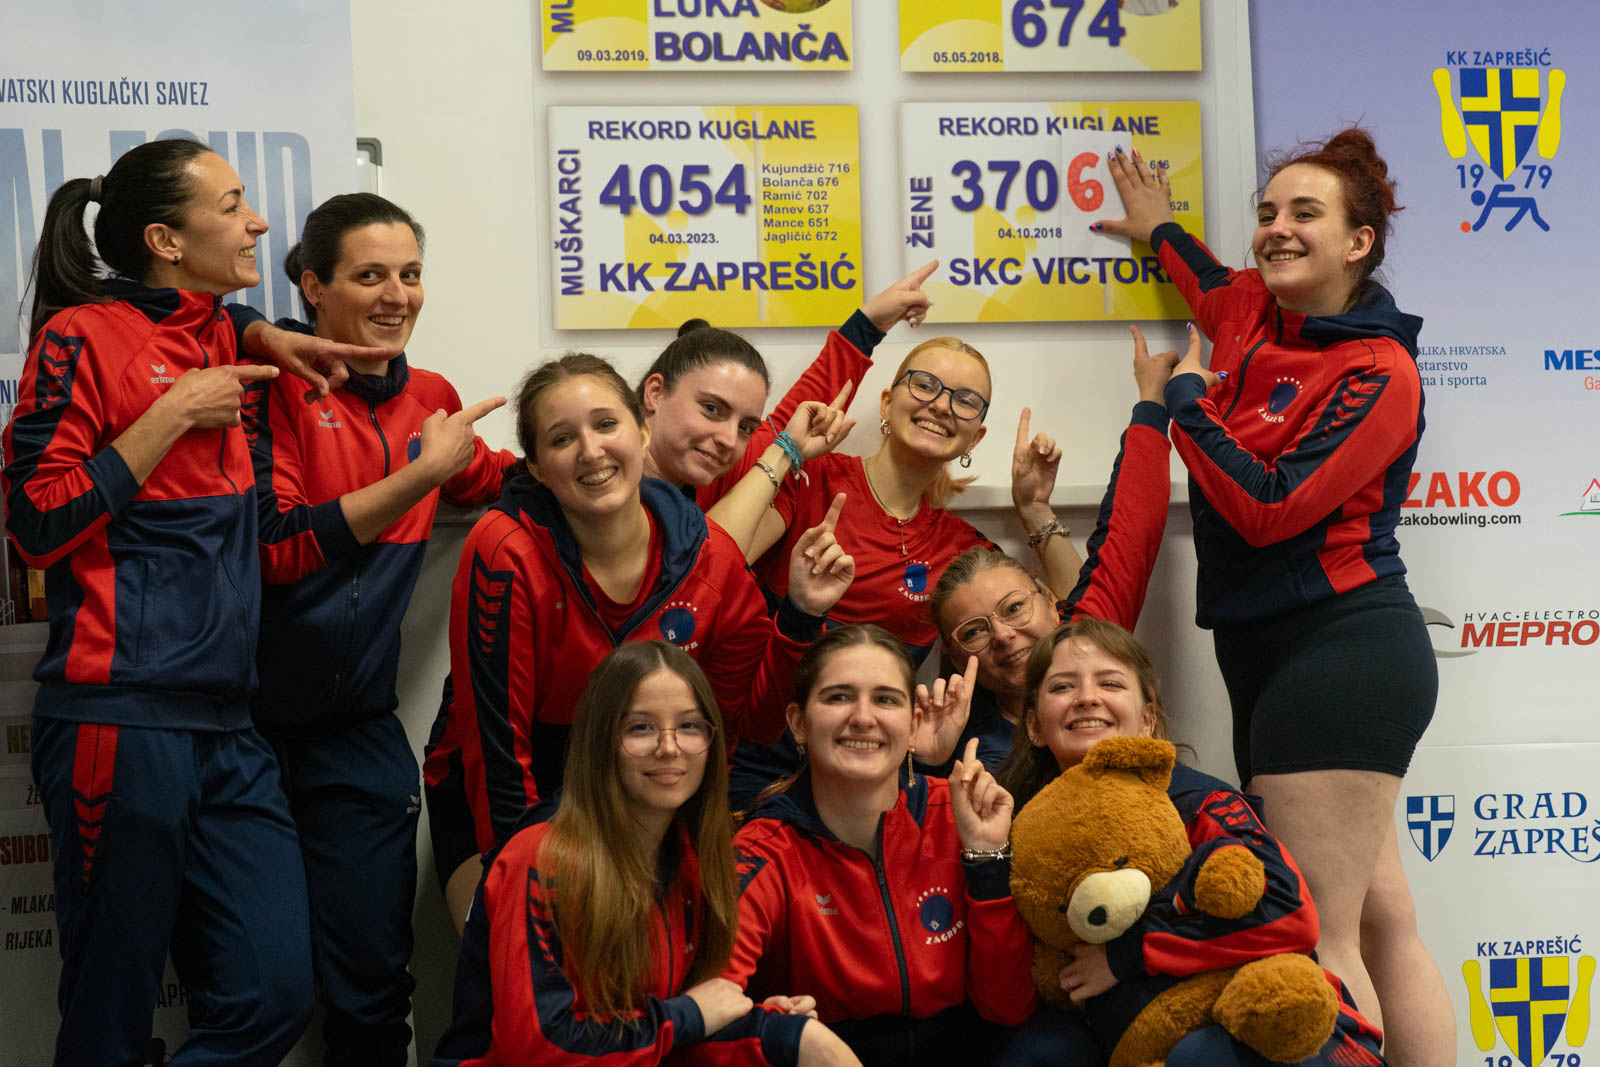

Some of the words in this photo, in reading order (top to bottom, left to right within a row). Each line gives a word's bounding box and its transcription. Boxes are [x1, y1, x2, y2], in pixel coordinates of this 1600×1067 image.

[1011, 0, 1126, 47] 674
[654, 24, 849, 62] BOLANČA
[577, 50, 648, 62] 09.03.2019.
[933, 52, 1003, 63] 05.05.2018.
[1447, 51, 1468, 66] KK
[1473, 47, 1552, 66] ZAPREŠIĆ
[62, 76, 149, 105] KUGLAČKI
[156, 81, 209, 106] SAVEZ
[588, 120, 691, 140] REKORD
[699, 120, 817, 140] KUGLANE
[939, 116, 1039, 136] REKORD
[762, 163, 825, 176] Kujundžić
[828, 163, 850, 174] 716
[1456, 164, 1484, 189] 19
[1522, 164, 1553, 189] 79
[599, 163, 752, 216] 4054
[762, 177, 813, 187] Bolanča
[817, 177, 839, 187] 676
[763, 190, 802, 201] Ramić
[806, 190, 828, 201] 702
[763, 204, 804, 215] Manev
[807, 204, 829, 214] 637
[905, 176, 933, 249] ŽENE
[554, 149, 583, 296] MUŠKARCI
[764, 218, 804, 228] Mance
[808, 217, 829, 228] 651
[649, 233, 719, 244] 04.03.2023.
[763, 231, 812, 244] Jagličić
[816, 231, 838, 241] 672
[599, 262, 655, 292] KK
[664, 252, 856, 292] ZAPREŠIĆ
[949, 257, 1023, 286] SKC
[1032, 257, 1173, 285] VICTOR
[1449, 345, 1507, 356] HRVATSKA
[151, 376, 175, 384] erima
[1440, 374, 1444, 386] i
[1447, 375, 1487, 389] sporta
[1400, 471, 1520, 508] ZAKO
[1461, 620, 1600, 648] MEPRO
[1474, 792, 1587, 820] GRAD
[0, 834, 53, 866] SUBO
[5, 929, 53, 951] RIJEKA
[925, 920, 964, 945] ZAGREB
[1477, 942, 1498, 957] KK
[1503, 934, 1582, 956] ZAPREŠIĆ
